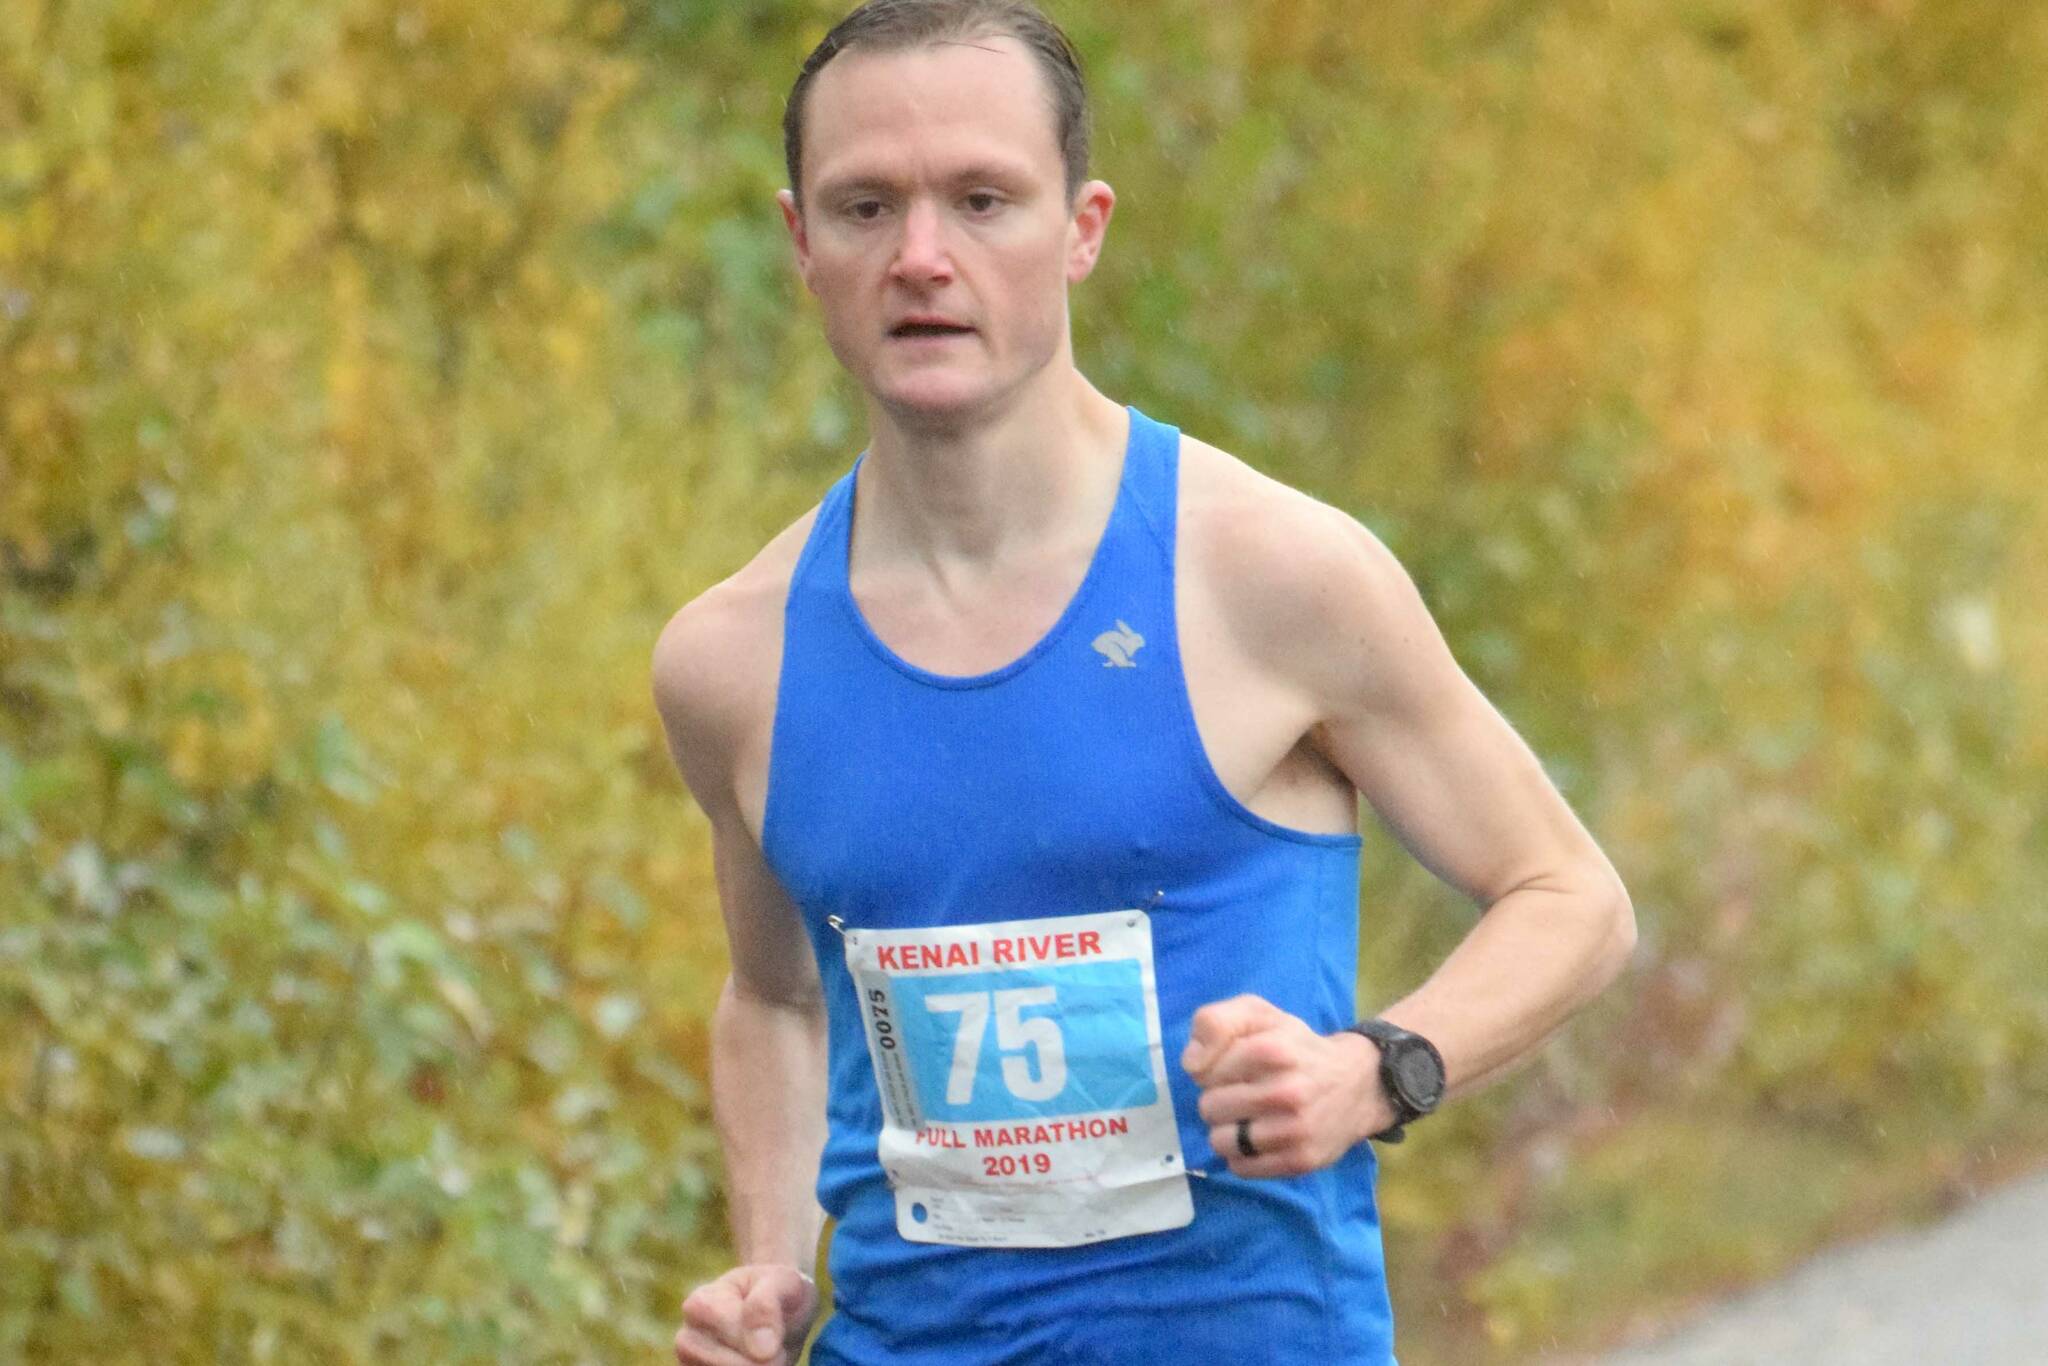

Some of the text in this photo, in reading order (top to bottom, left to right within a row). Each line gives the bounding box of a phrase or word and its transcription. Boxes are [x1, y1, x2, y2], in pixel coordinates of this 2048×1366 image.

[877, 931, 1102, 971] KENAI RIVER
[868, 989, 897, 1051] 0075
[924, 986, 1067, 1106] 75
[915, 1117, 1128, 1149] FULL MARATHON
[983, 1153, 1052, 1176] 2019
